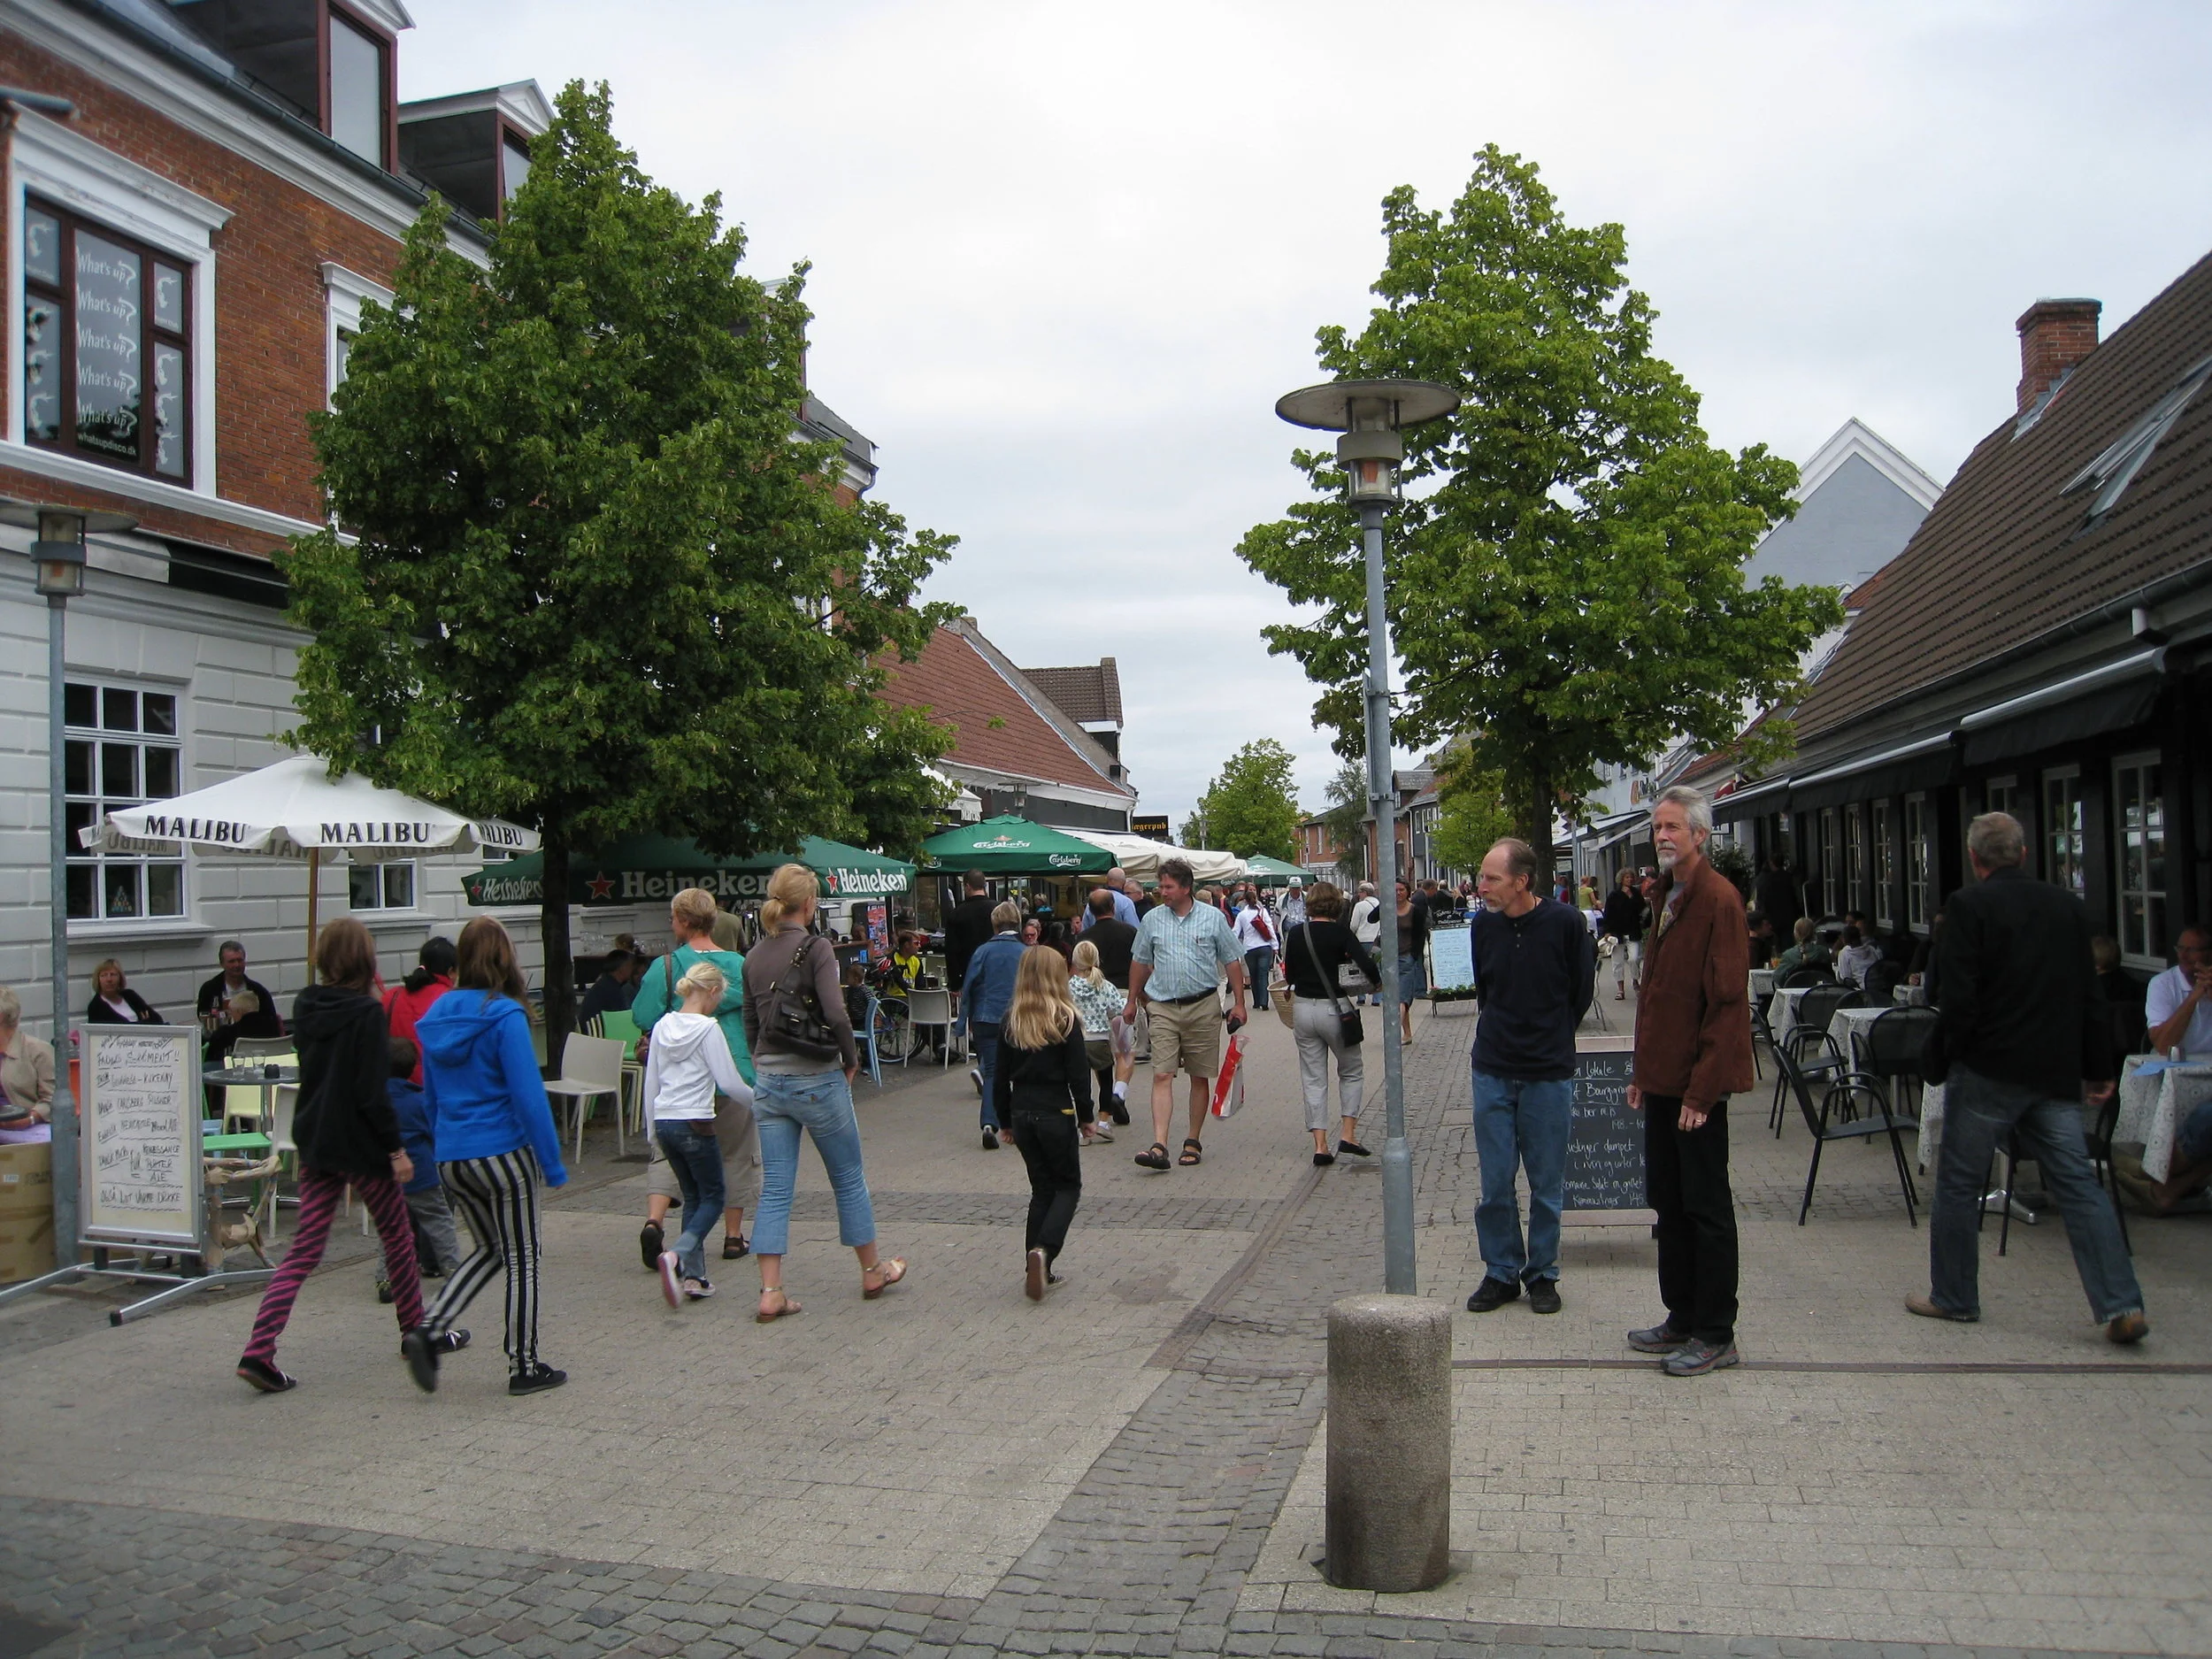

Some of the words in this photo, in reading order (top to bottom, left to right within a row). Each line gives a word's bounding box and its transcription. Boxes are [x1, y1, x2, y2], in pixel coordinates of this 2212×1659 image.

[76, 246, 111, 275] What's
[76, 283, 111, 311] What's
[77, 321, 111, 349] What's
[77, 357, 111, 387] What's
[78, 396, 111, 424] What's
[144, 815, 248, 843] MALIBU
[320, 822, 429, 843] MALIBU
[1133, 822, 1166, 832] ægerpub
[972, 840, 1032, 849] Carlsberg
[1048, 854, 1082, 868] Carlsberg
[837, 867, 908, 894] Heineken
